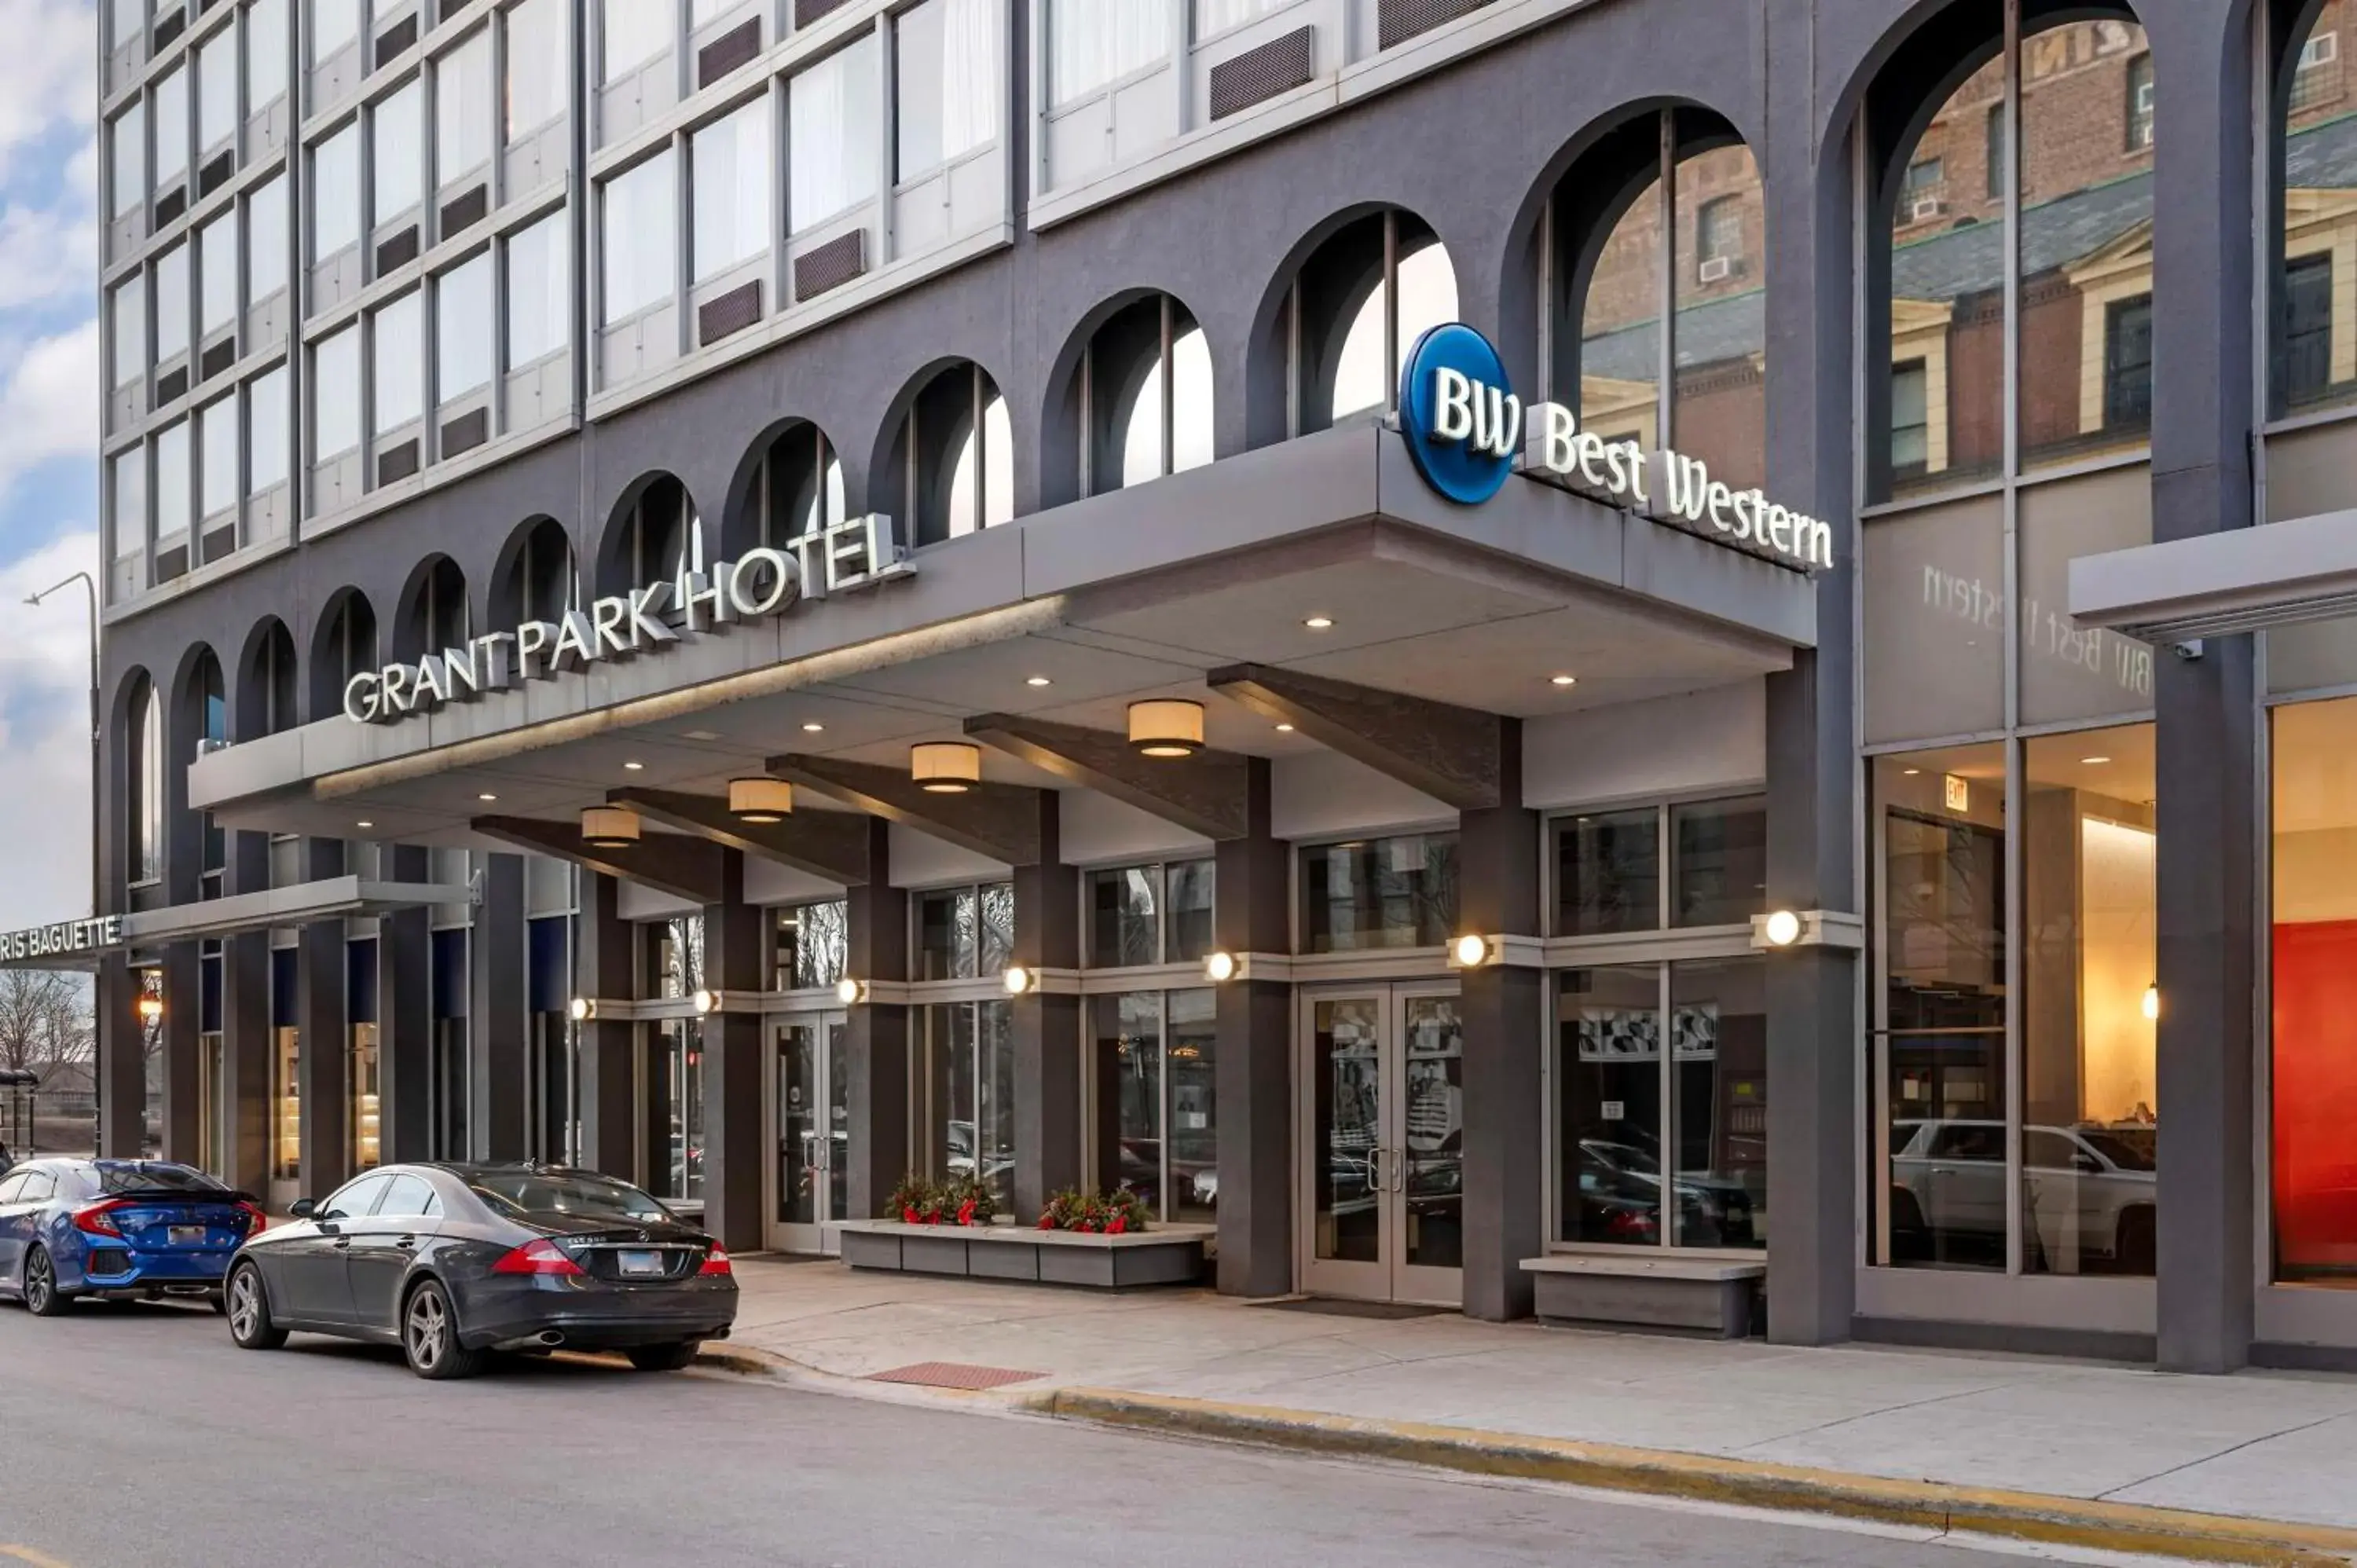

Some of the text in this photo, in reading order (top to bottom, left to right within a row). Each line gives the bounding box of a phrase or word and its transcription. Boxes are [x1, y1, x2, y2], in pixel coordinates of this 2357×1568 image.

[1434, 366, 1520, 458] BW
[1541, 401, 1834, 569] Best Western
[343, 512, 917, 724] GRANT PARK HOTEL
[0, 914, 119, 962] RIS BAGUETTE
